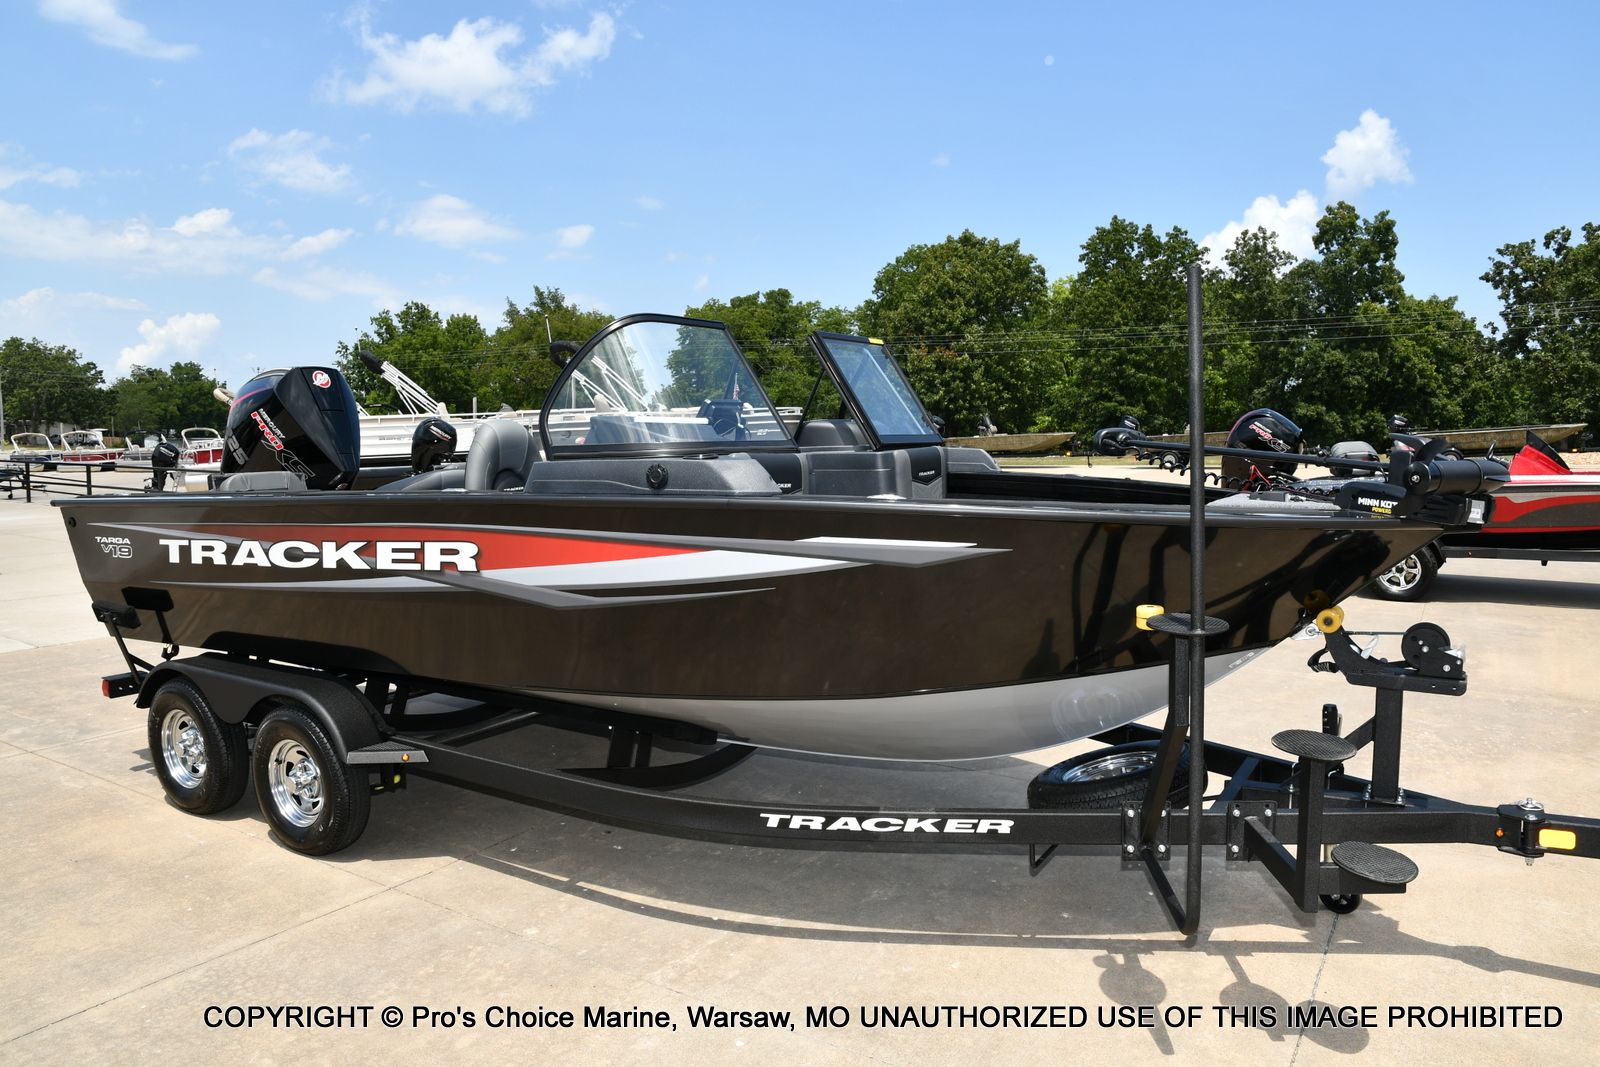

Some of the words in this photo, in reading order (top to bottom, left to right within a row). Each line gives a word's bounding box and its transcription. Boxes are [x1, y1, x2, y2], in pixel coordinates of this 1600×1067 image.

[250, 411, 284, 451] PRO
[259, 408, 286, 439] MERCURY
[1357, 497, 1379, 508] MINN
[1380, 499, 1399, 509] KOT
[95, 536, 131, 545] TARGA
[100, 544, 133, 559] V19
[159, 539, 479, 573] TRACKER
[759, 812, 1015, 834] TRACKER
